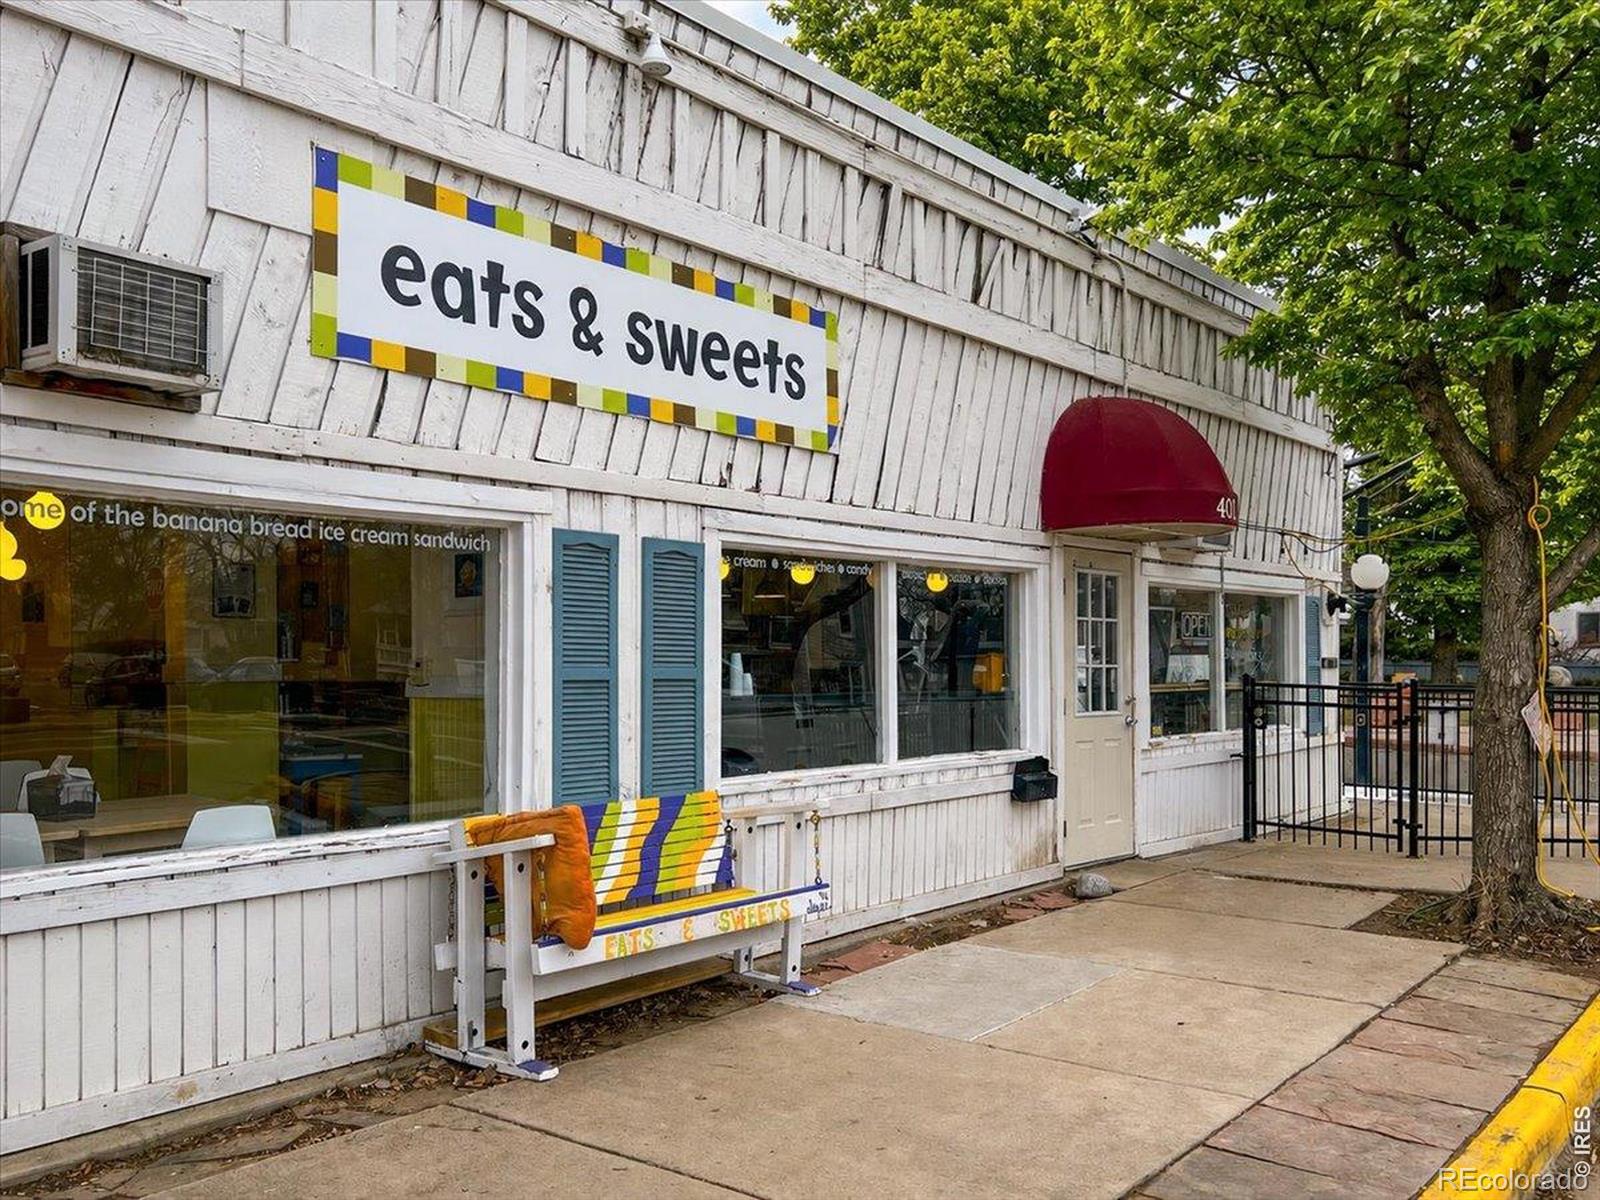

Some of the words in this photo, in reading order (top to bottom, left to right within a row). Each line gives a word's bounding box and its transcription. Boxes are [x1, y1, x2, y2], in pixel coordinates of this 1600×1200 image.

[381, 244, 546, 339] eats
[569, 286, 604, 357] &
[625, 310, 807, 401] sweets
[71, 501, 97, 523] of
[104, 503, 146, 527] the
[152, 506, 244, 535] banana
[250, 515, 313, 540] bread
[319, 521, 346, 542] ice
[351, 528, 409, 546] cream
[414, 531, 491, 552] sandwich
[733, 556, 767, 569] cream
[1182, 614, 1212, 637] OPEN
[604, 927, 655, 961] EATS
[717, 898, 793, 933] SWEETS
